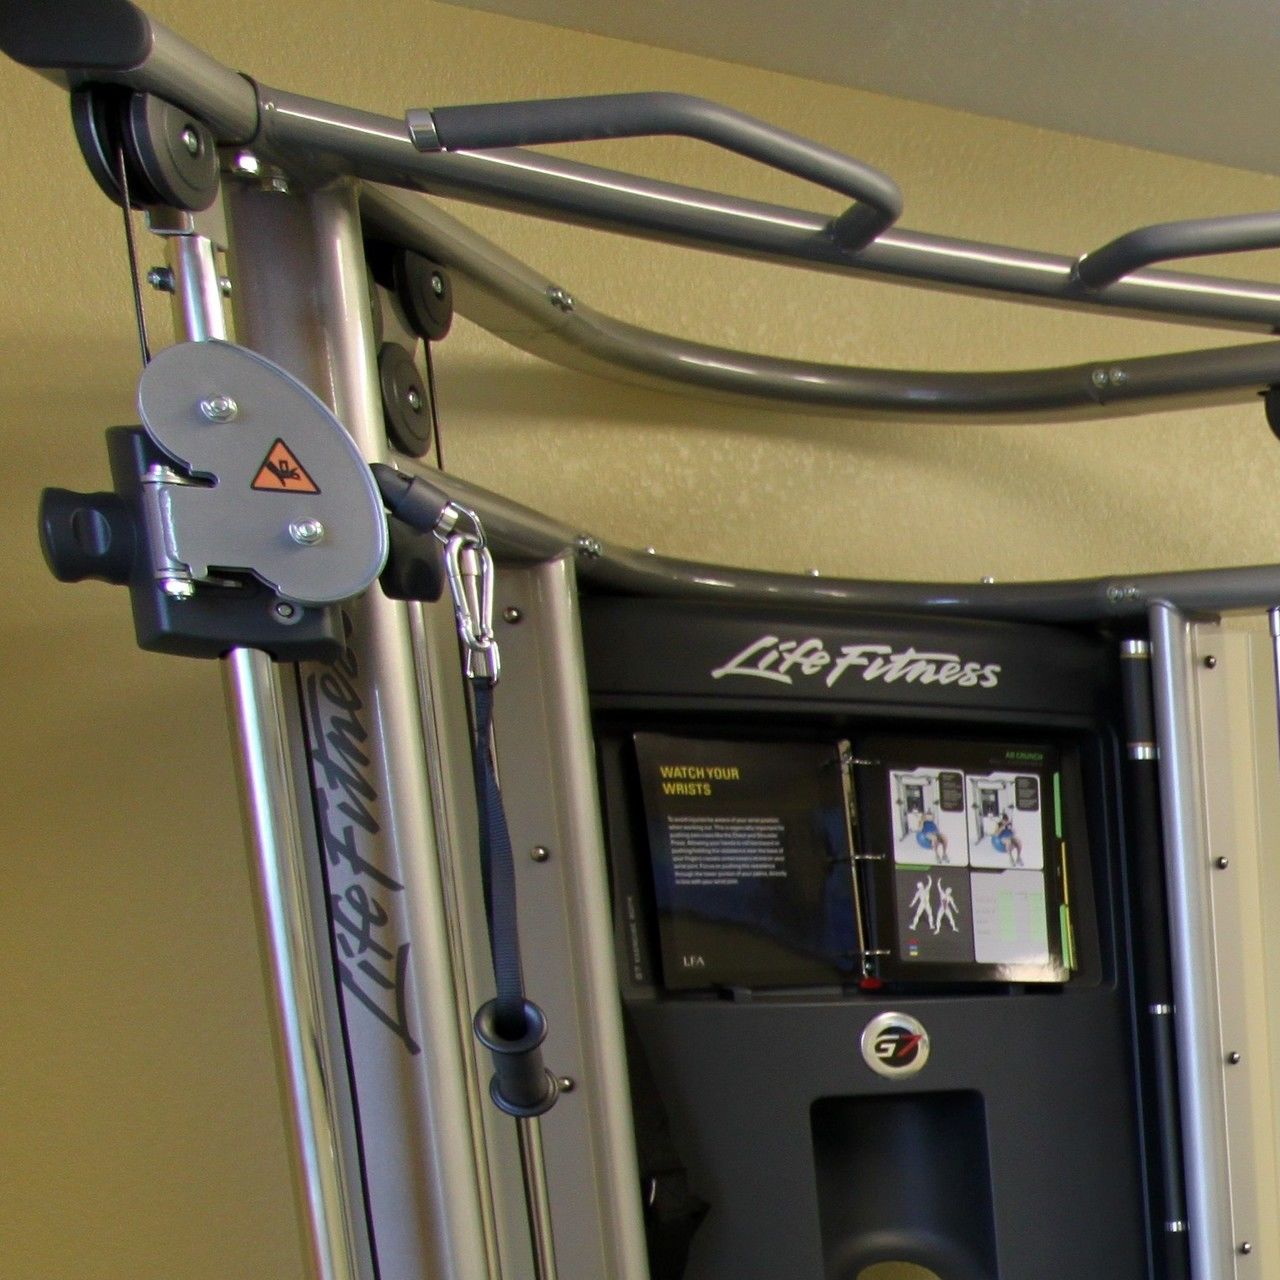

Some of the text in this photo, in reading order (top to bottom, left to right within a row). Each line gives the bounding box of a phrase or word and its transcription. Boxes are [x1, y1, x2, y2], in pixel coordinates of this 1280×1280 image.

[711, 635, 1002, 688] Life Fitness
[660, 765, 740, 780] WATCH YOUR
[663, 782, 712, 796] WRISTS
[331, 883, 422, 1056] Life
[876, 1034, 923, 1057] G7
